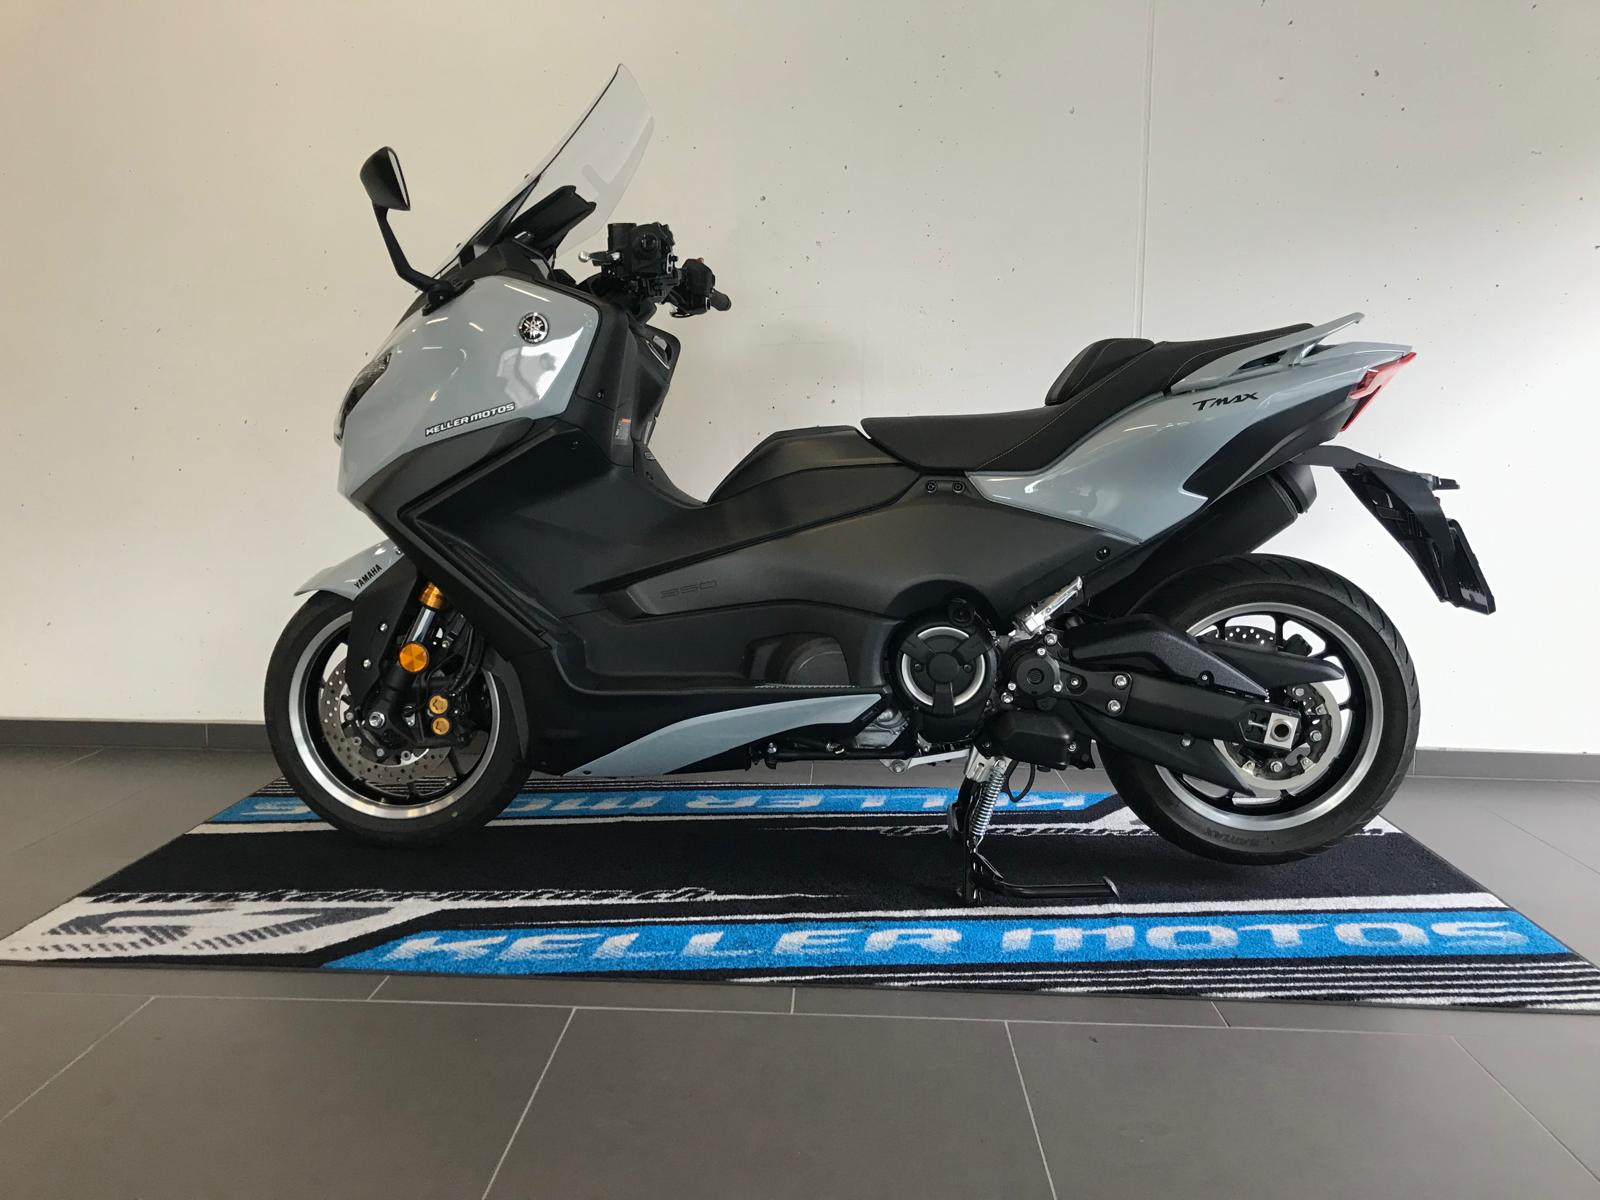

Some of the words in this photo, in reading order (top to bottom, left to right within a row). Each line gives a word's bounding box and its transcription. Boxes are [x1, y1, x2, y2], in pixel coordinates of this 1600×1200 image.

[1192, 392, 1258, 411] TMAX
[425, 415, 469, 437] KELLER
[470, 402, 515, 422] MOTOS
[354, 563, 382, 590] YAMAHA
[385, 927, 963, 961] KELLER
[1001, 922, 1529, 952] MOTOS
